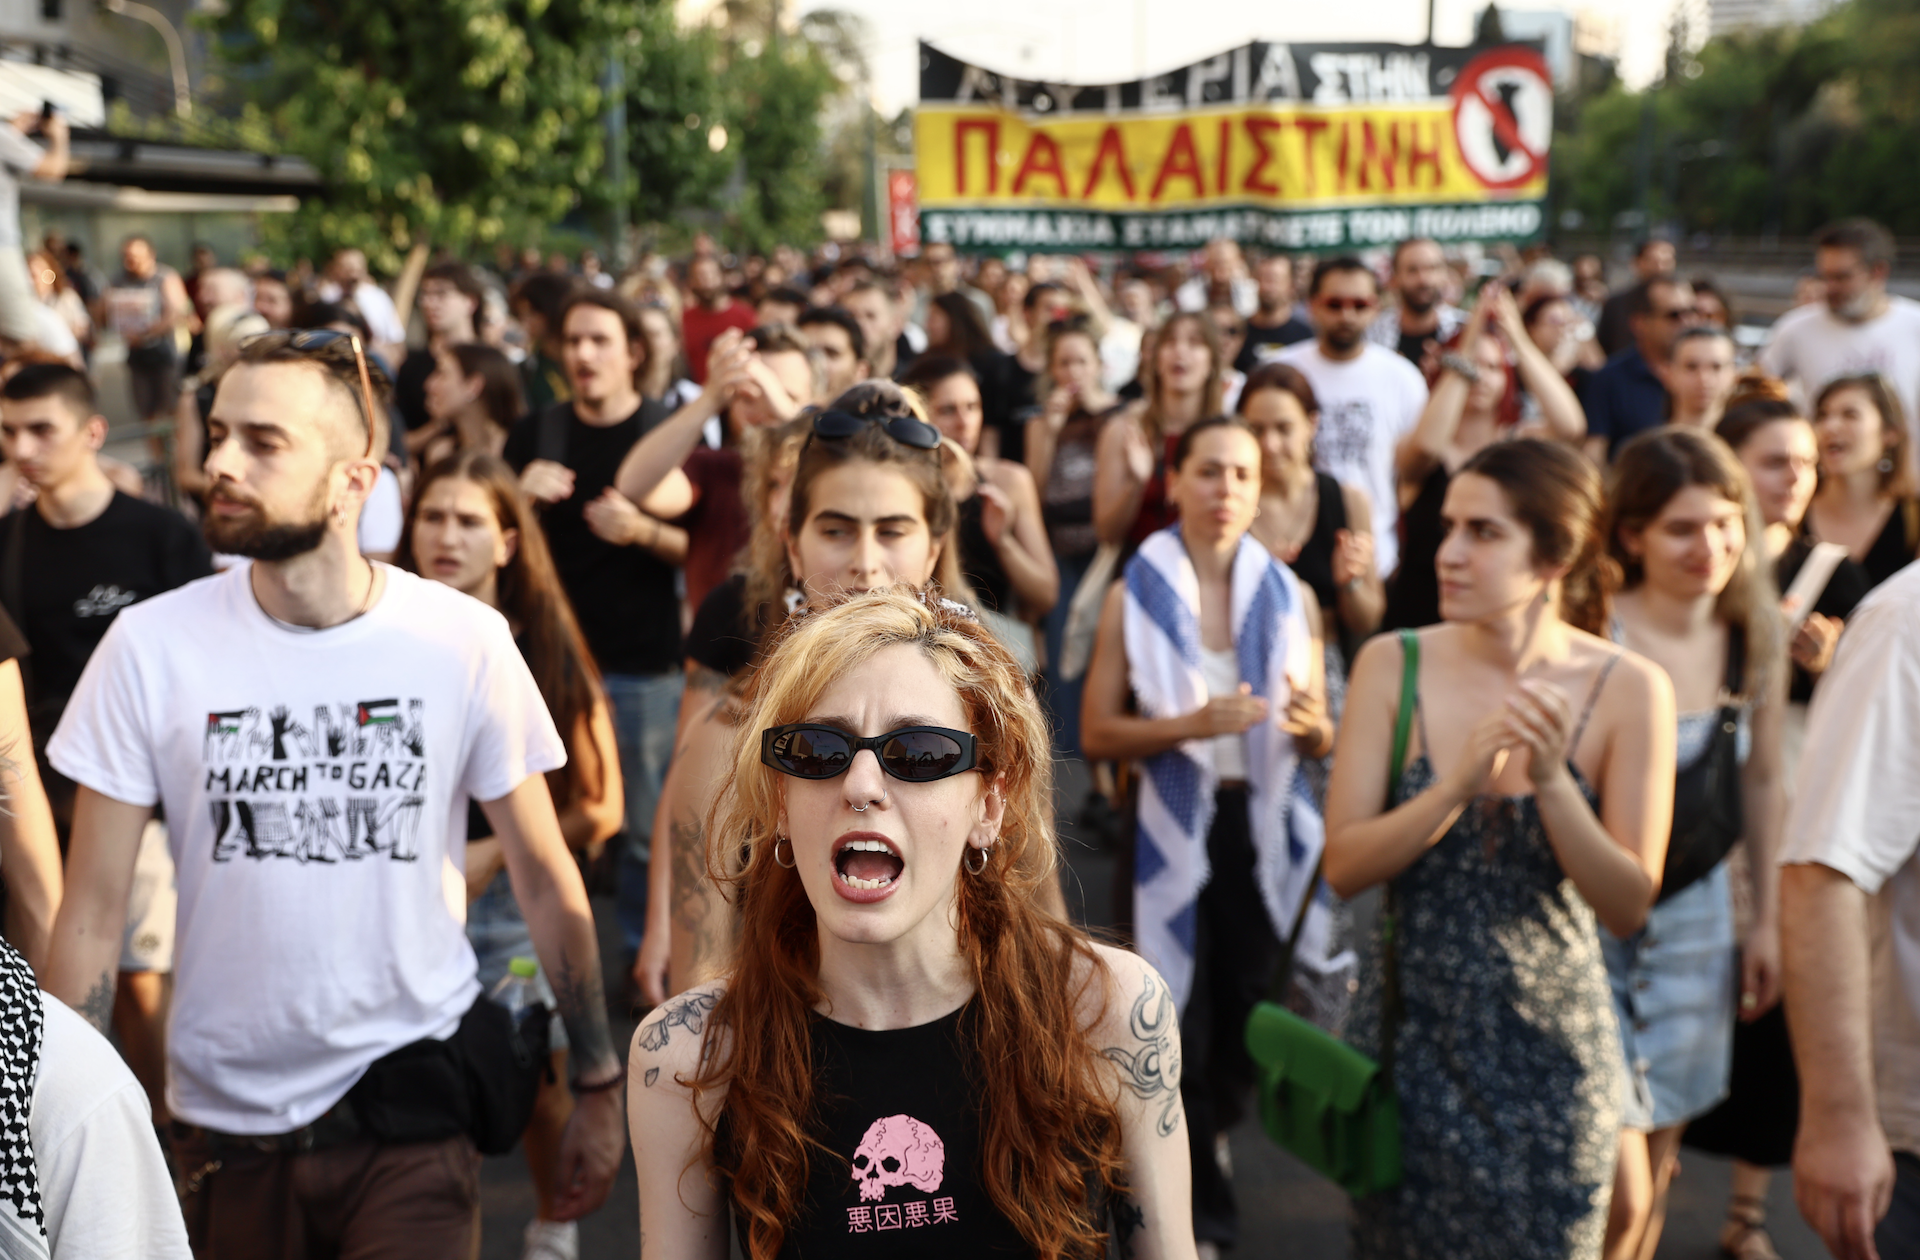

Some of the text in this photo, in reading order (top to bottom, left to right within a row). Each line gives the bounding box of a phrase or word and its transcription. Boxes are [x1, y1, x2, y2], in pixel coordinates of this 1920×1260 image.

[1310, 51, 1430, 106] ΣΤΗΝ
[954, 115, 1443, 200] ΠΑΛΑΙΣΤΙΝΗ
[206, 761, 426, 793] MARCH TO GAZA
[846, 1196, 960, 1234] 悪因悪果
